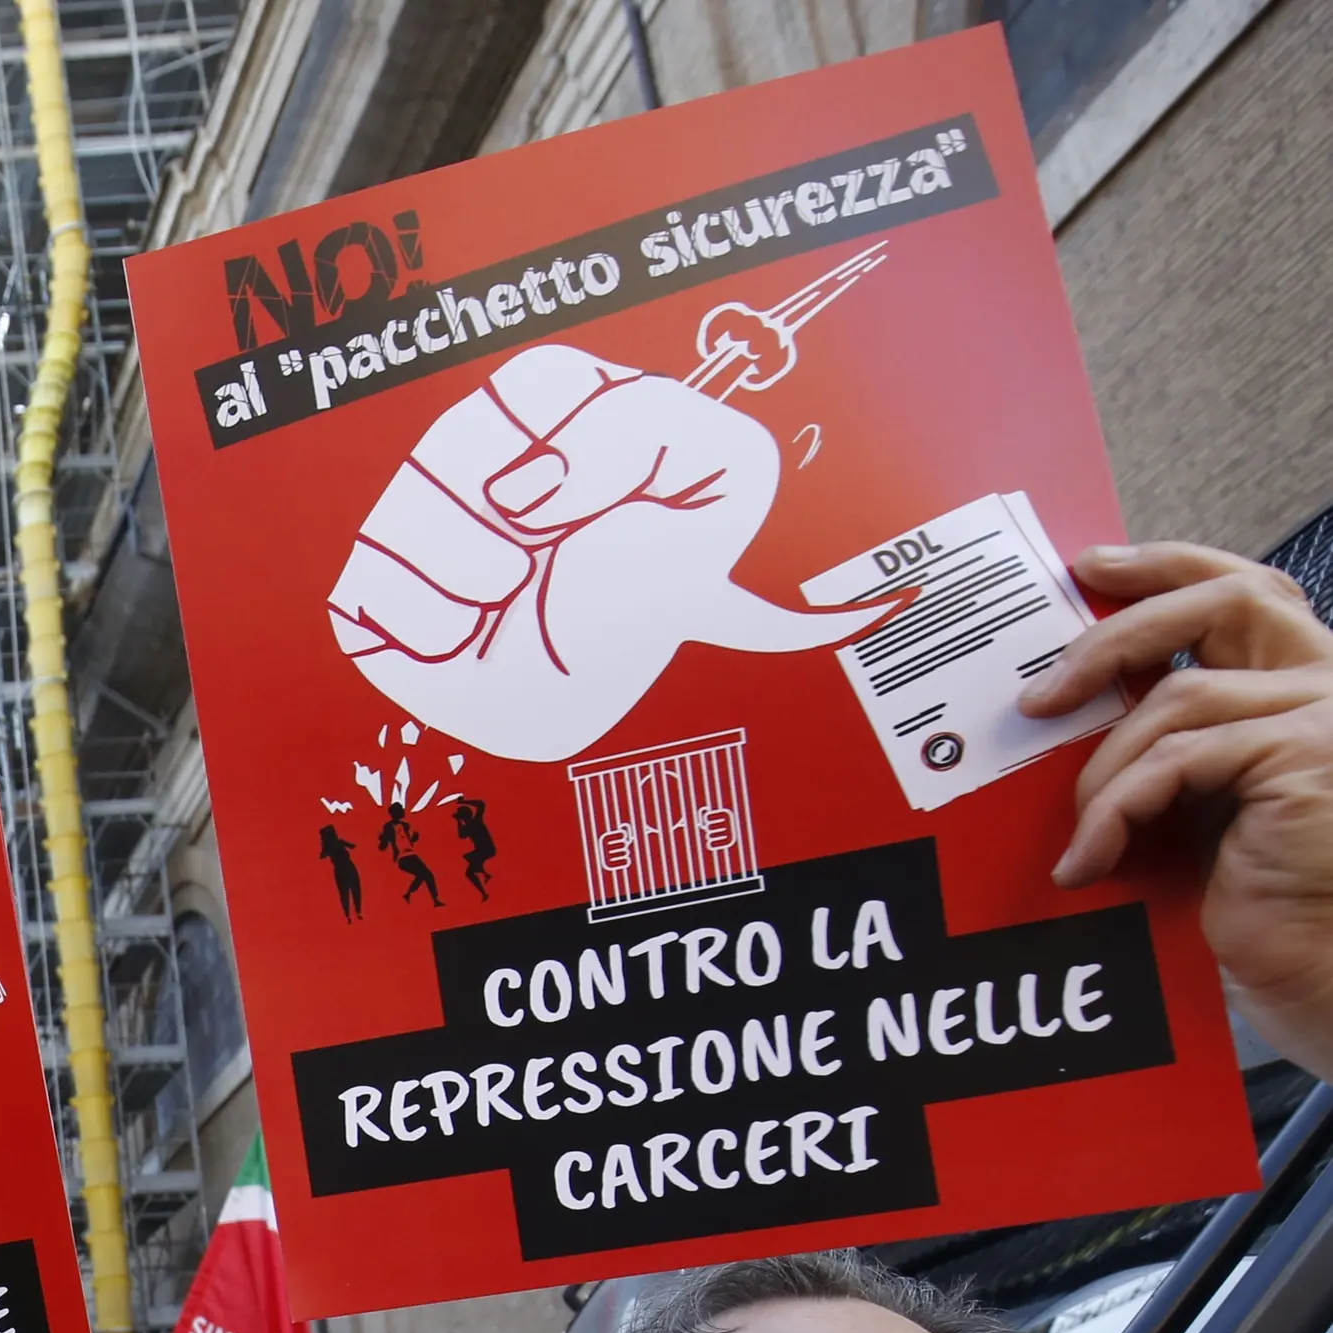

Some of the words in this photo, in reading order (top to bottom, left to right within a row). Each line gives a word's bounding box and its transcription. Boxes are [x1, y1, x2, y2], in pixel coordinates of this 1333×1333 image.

[223, 210, 428, 351] NO!
[213, 360, 268, 428] al
[873, 531, 942, 579] DDL
[483, 921, 782, 1028] CONTRO
[811, 899, 903, 970] LA
[338, 1008, 843, 1148] REPRESSIONE
[867, 963, 1112, 1062] NELLE
[553, 1105, 880, 1211] CARCERI
